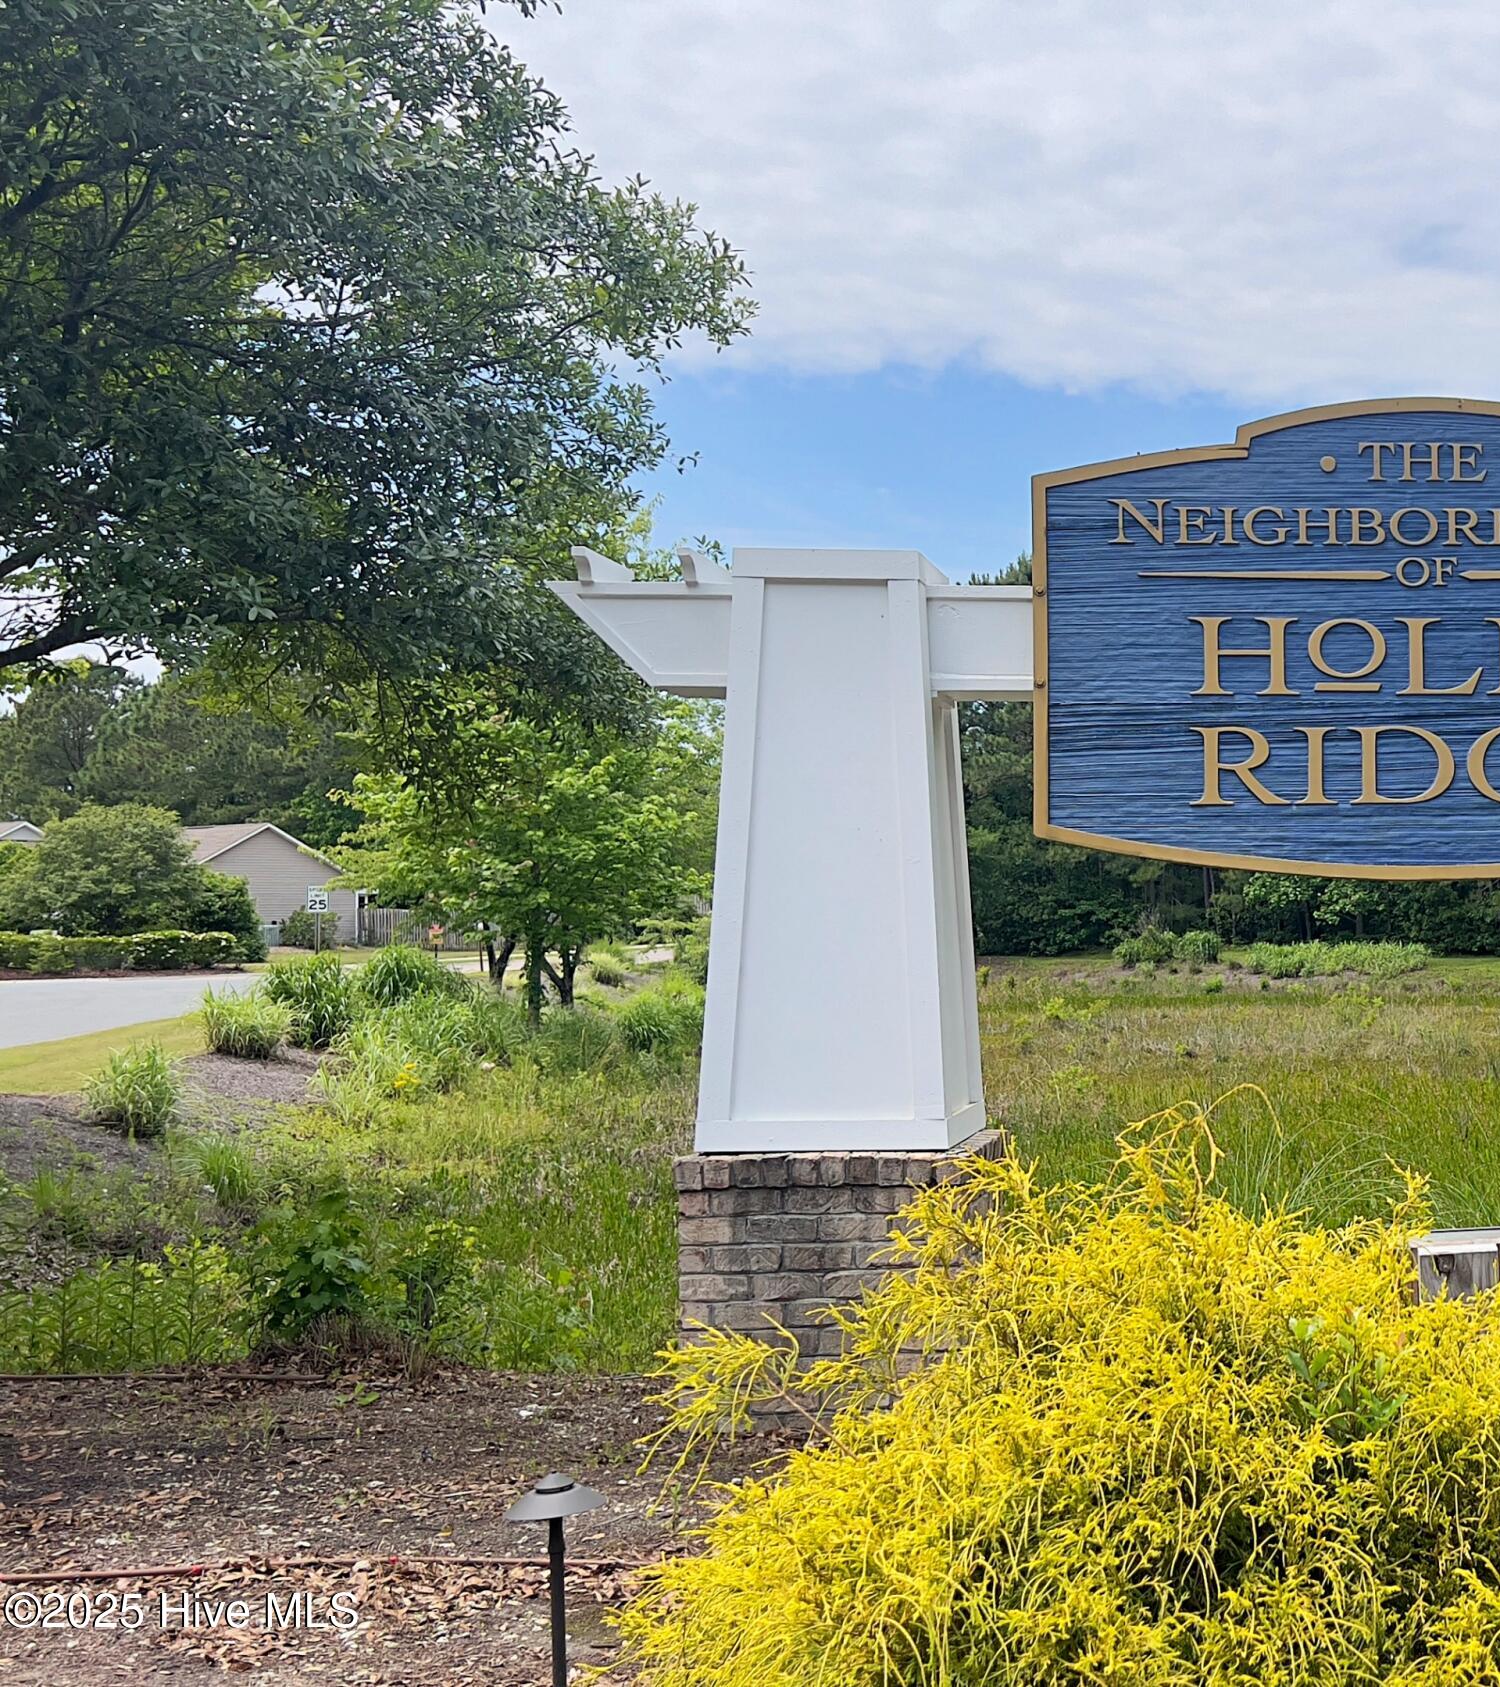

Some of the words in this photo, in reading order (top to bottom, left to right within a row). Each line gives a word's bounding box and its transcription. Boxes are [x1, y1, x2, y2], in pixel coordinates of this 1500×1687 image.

[1358, 442, 1488, 483] THE
[1395, 557, 1458, 587] OF
[309, 899, 327, 910] 25
